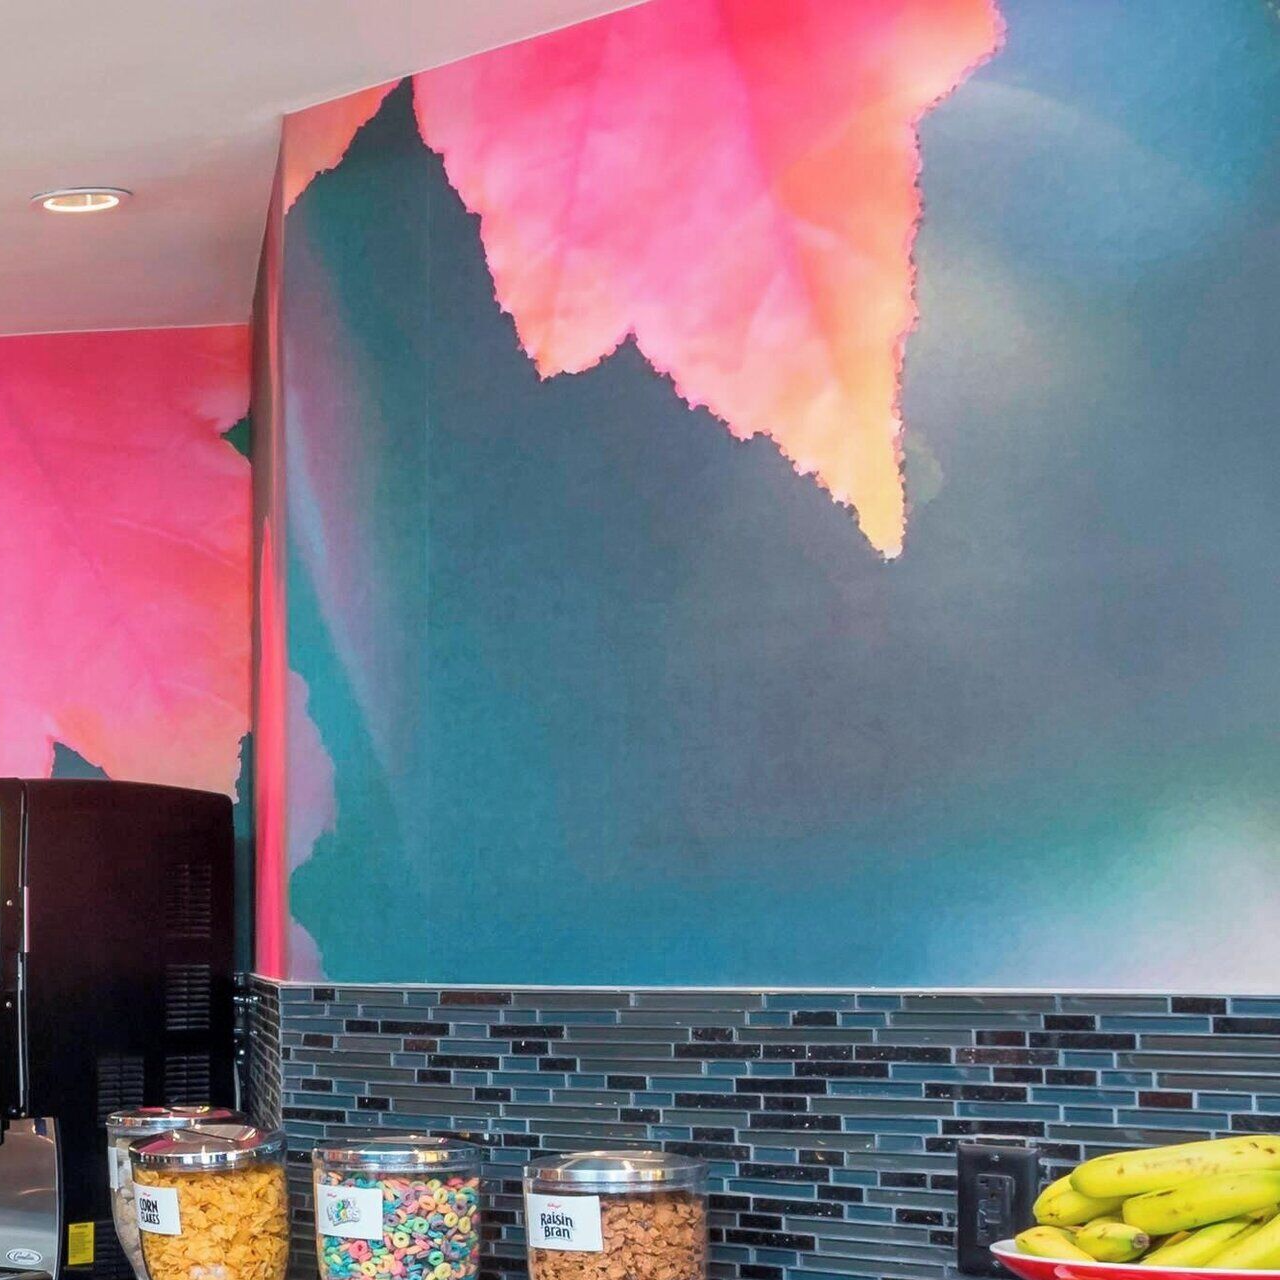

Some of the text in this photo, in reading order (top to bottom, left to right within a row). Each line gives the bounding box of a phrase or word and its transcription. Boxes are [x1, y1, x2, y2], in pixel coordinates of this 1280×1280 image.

[139, 1197, 159, 1214] CORN
[540, 1211, 574, 1228] Raisin
[544, 1225, 571, 1240] Bran
